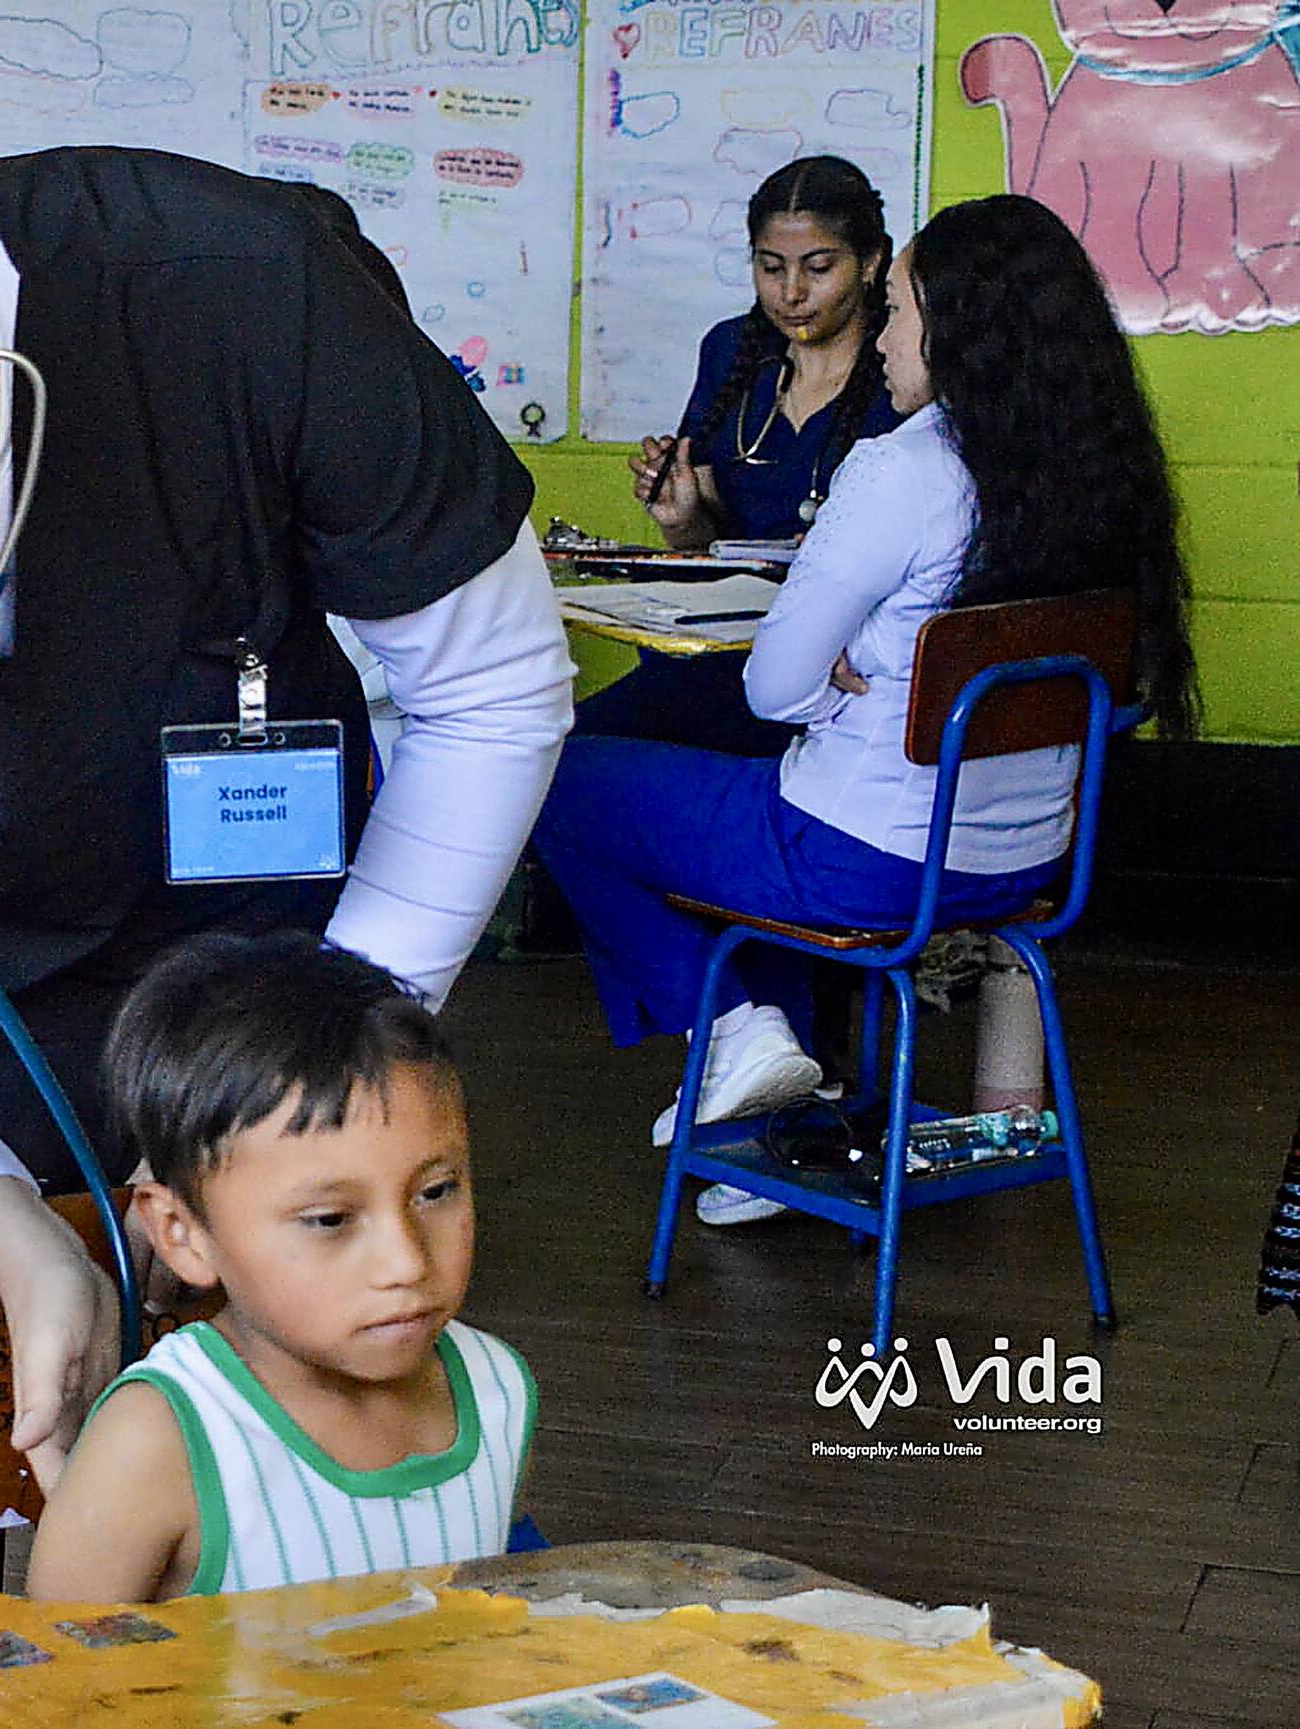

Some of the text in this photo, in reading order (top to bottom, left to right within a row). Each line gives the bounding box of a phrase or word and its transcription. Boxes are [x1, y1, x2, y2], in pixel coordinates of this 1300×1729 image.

[644, 6, 920, 60] REFRANES
[218, 784, 287, 801] Xander
[220, 806, 287, 823] Russell
